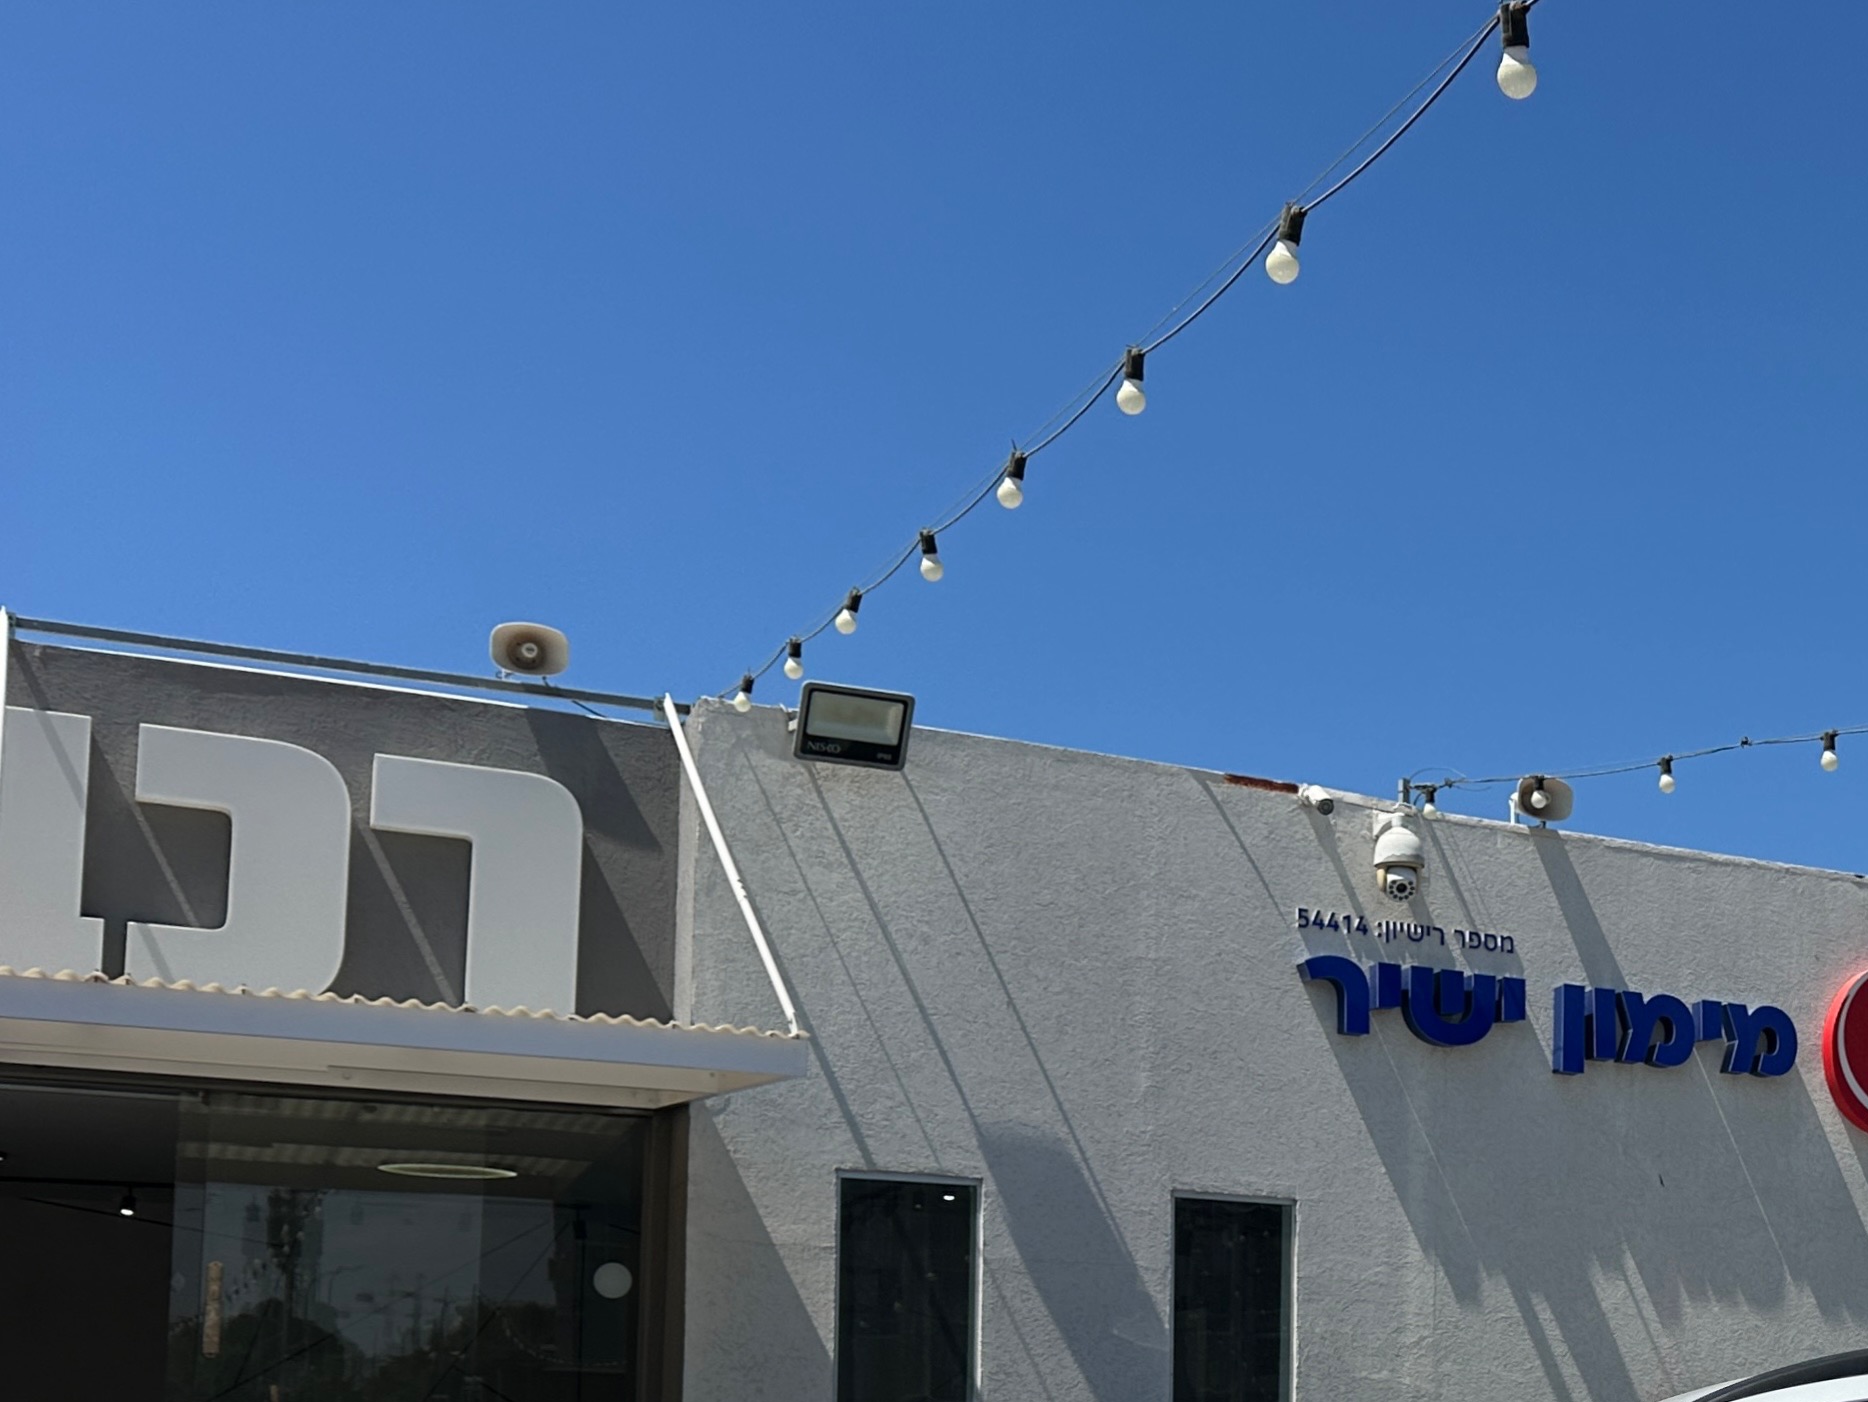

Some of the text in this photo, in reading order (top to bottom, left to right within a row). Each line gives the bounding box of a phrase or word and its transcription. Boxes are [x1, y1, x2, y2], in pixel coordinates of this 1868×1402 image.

[1297, 907, 1515, 954] מספר רישיון: 54414
[1298, 954, 1798, 1077] מימון ישיר
